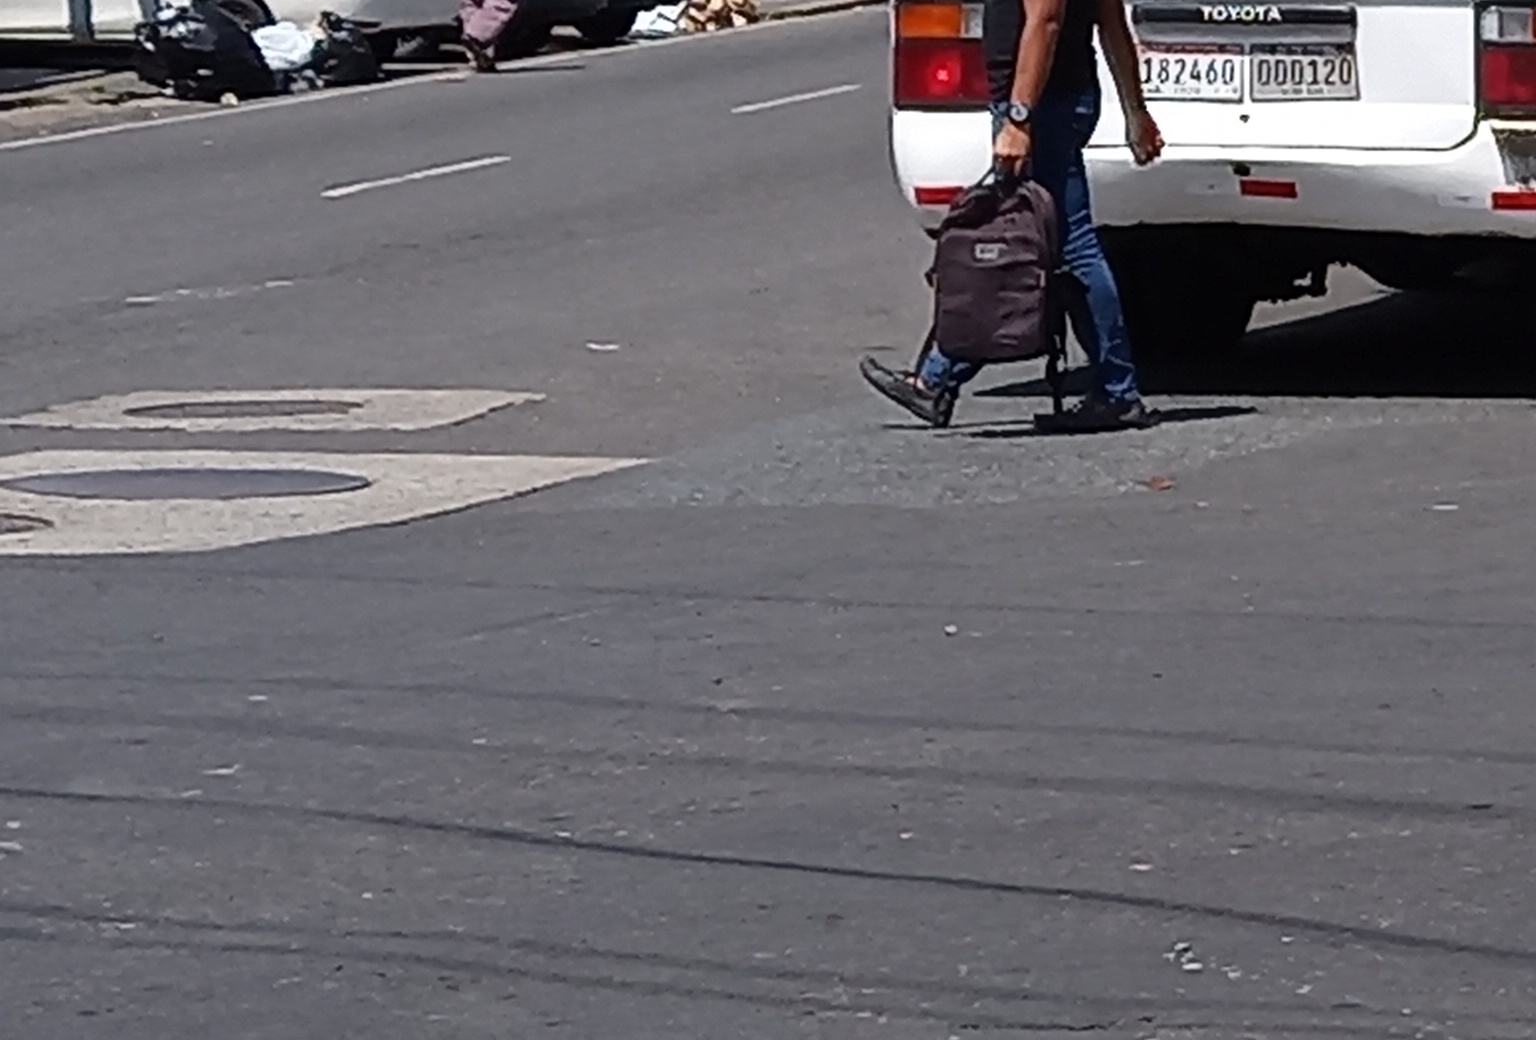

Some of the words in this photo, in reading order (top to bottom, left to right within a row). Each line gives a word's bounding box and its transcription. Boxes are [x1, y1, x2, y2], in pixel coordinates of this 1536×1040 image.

[1201, 5, 1283, 22] TOYOTA
[1142, 58, 1236, 86] 182460
[1257, 58, 1352, 87] 000120
